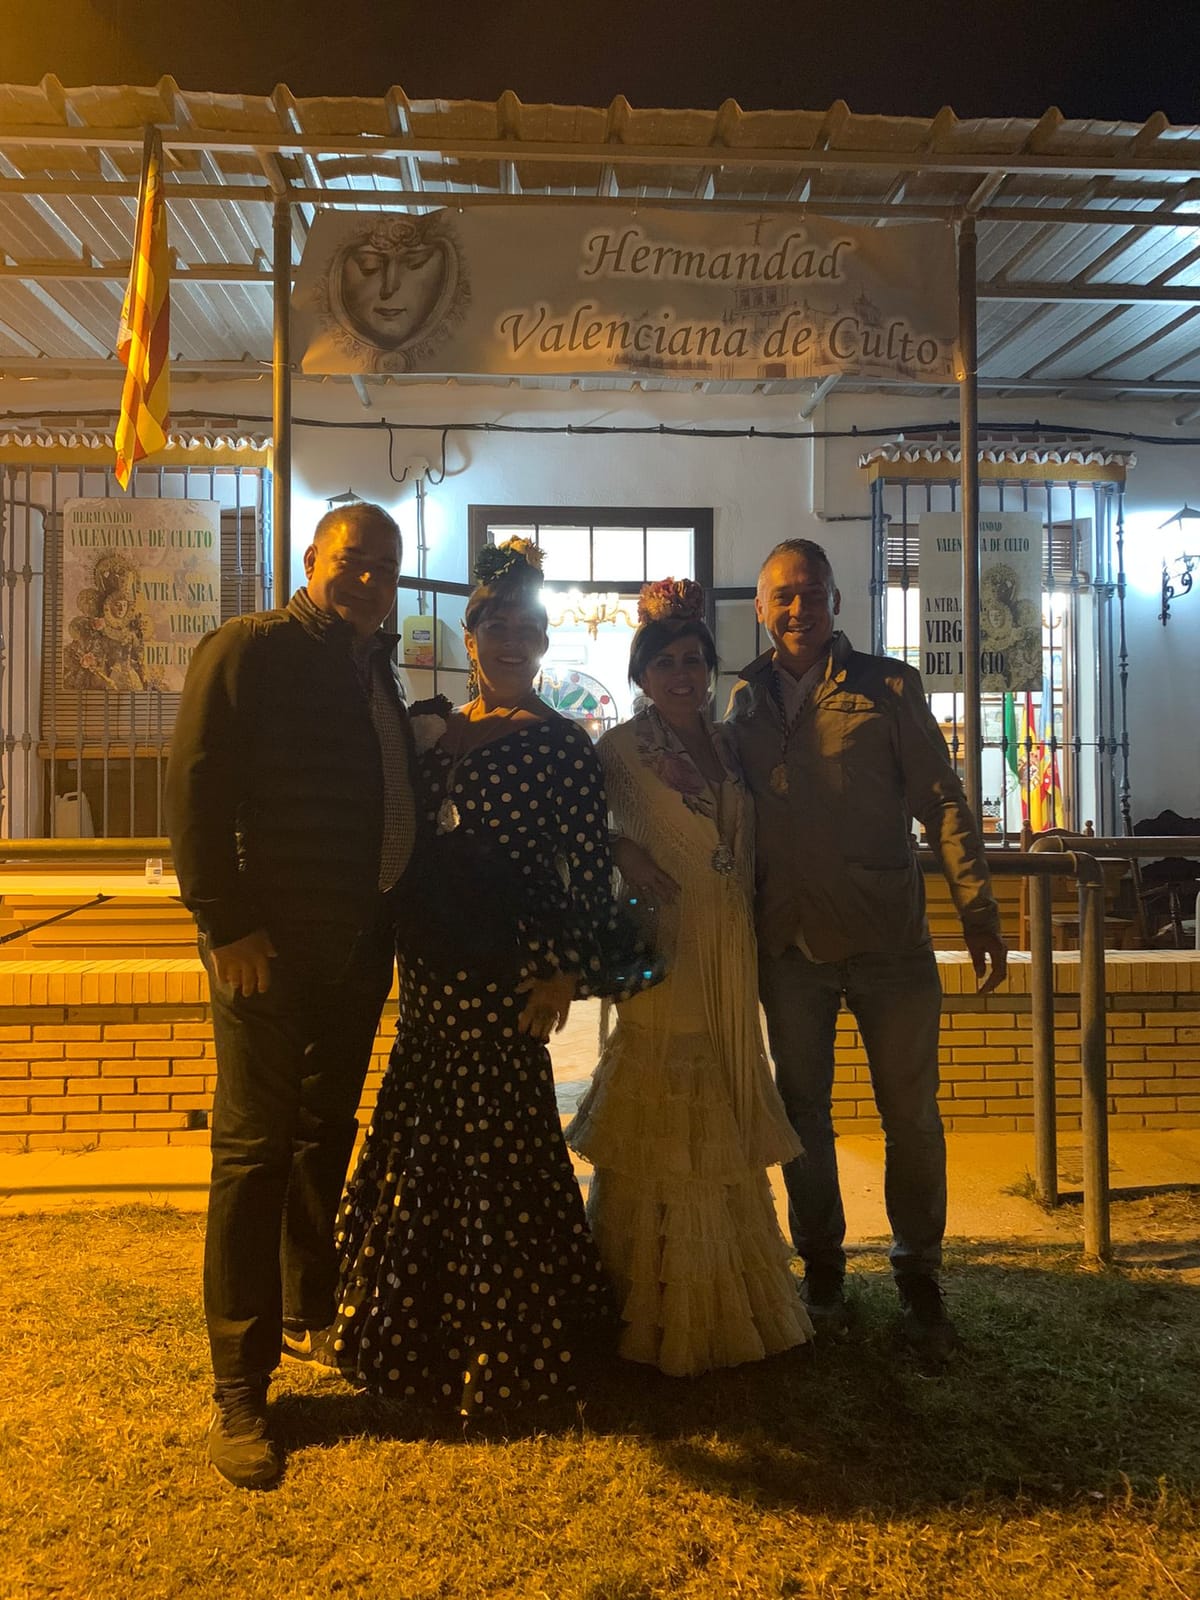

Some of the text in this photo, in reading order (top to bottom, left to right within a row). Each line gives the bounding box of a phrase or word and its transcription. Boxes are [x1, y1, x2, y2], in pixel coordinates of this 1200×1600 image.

[584, 230, 851, 281] Hermandad
[500, 305, 938, 365] Valenciana de Culto
[73, 511, 132, 523] HERMANDAD
[71, 529, 212, 548] VALENCIANA DE CULTO
[990, 537, 1000, 552] DE
[1003, 537, 1030, 553] CULTO
[144, 582, 182, 601] NTRA.
[188, 583, 218, 602] SRA.
[925, 597, 931, 612] A
[169, 615, 219, 632] VIRGEN
[925, 620, 962, 643] VIRG
[147, 647, 172, 665] DEL
[925, 651, 953, 675] DEL
